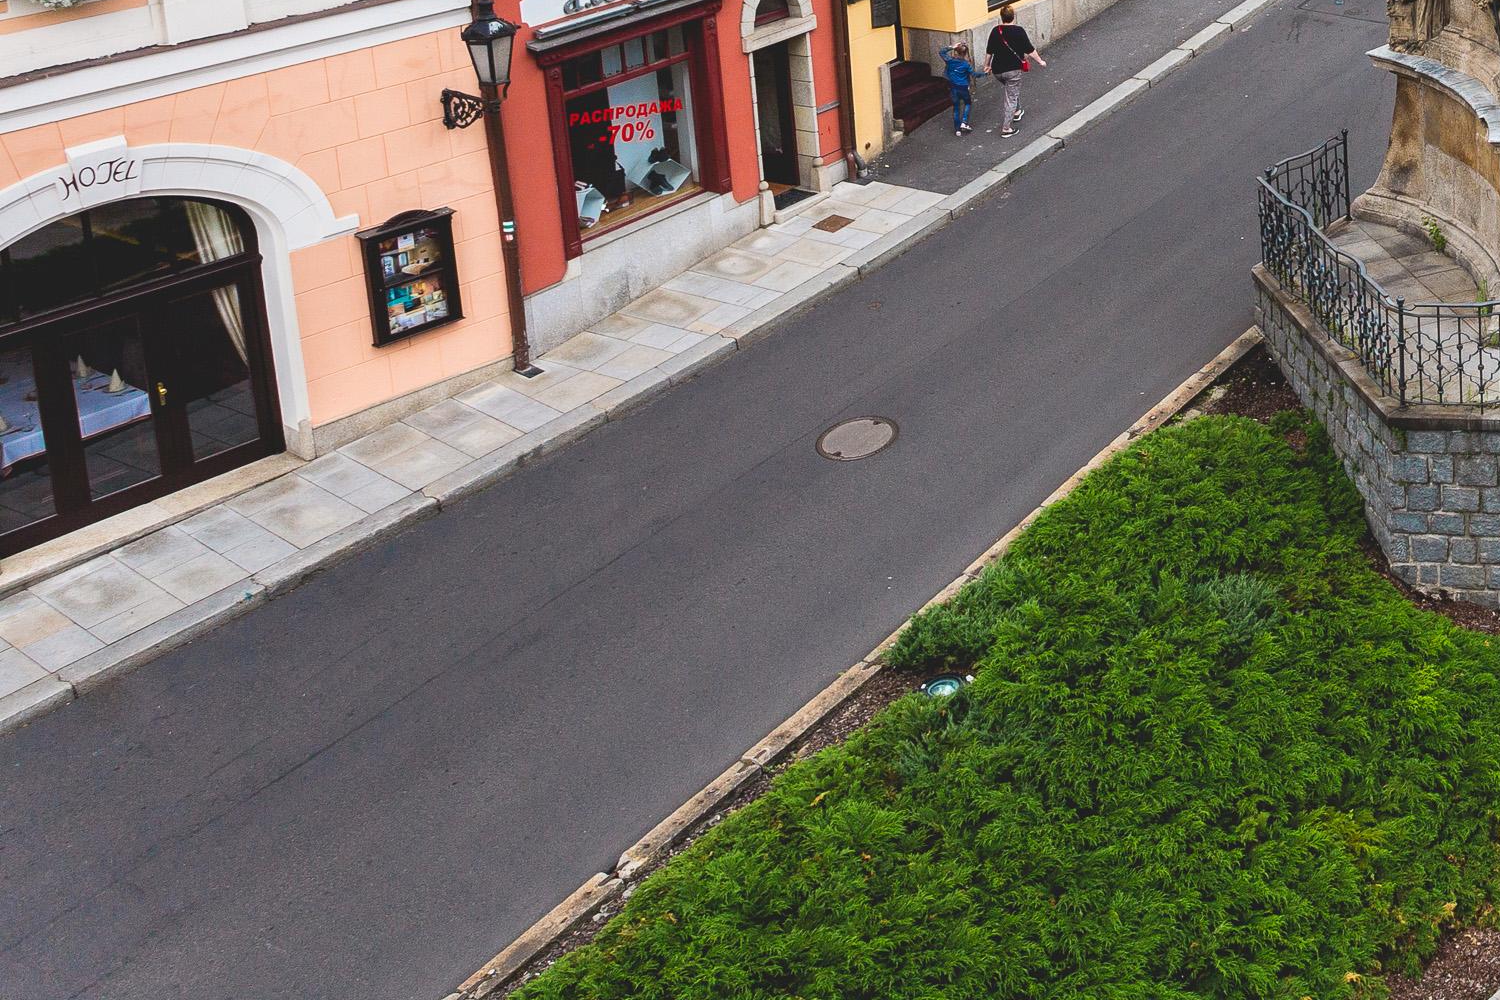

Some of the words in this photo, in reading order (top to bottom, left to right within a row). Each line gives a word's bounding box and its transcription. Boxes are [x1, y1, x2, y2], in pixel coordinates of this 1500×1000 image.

[569, 98, 684, 127] РАСПРОДАЖА
[598, 119, 655, 145] -70%
[58, 157, 138, 201] HOTEL
